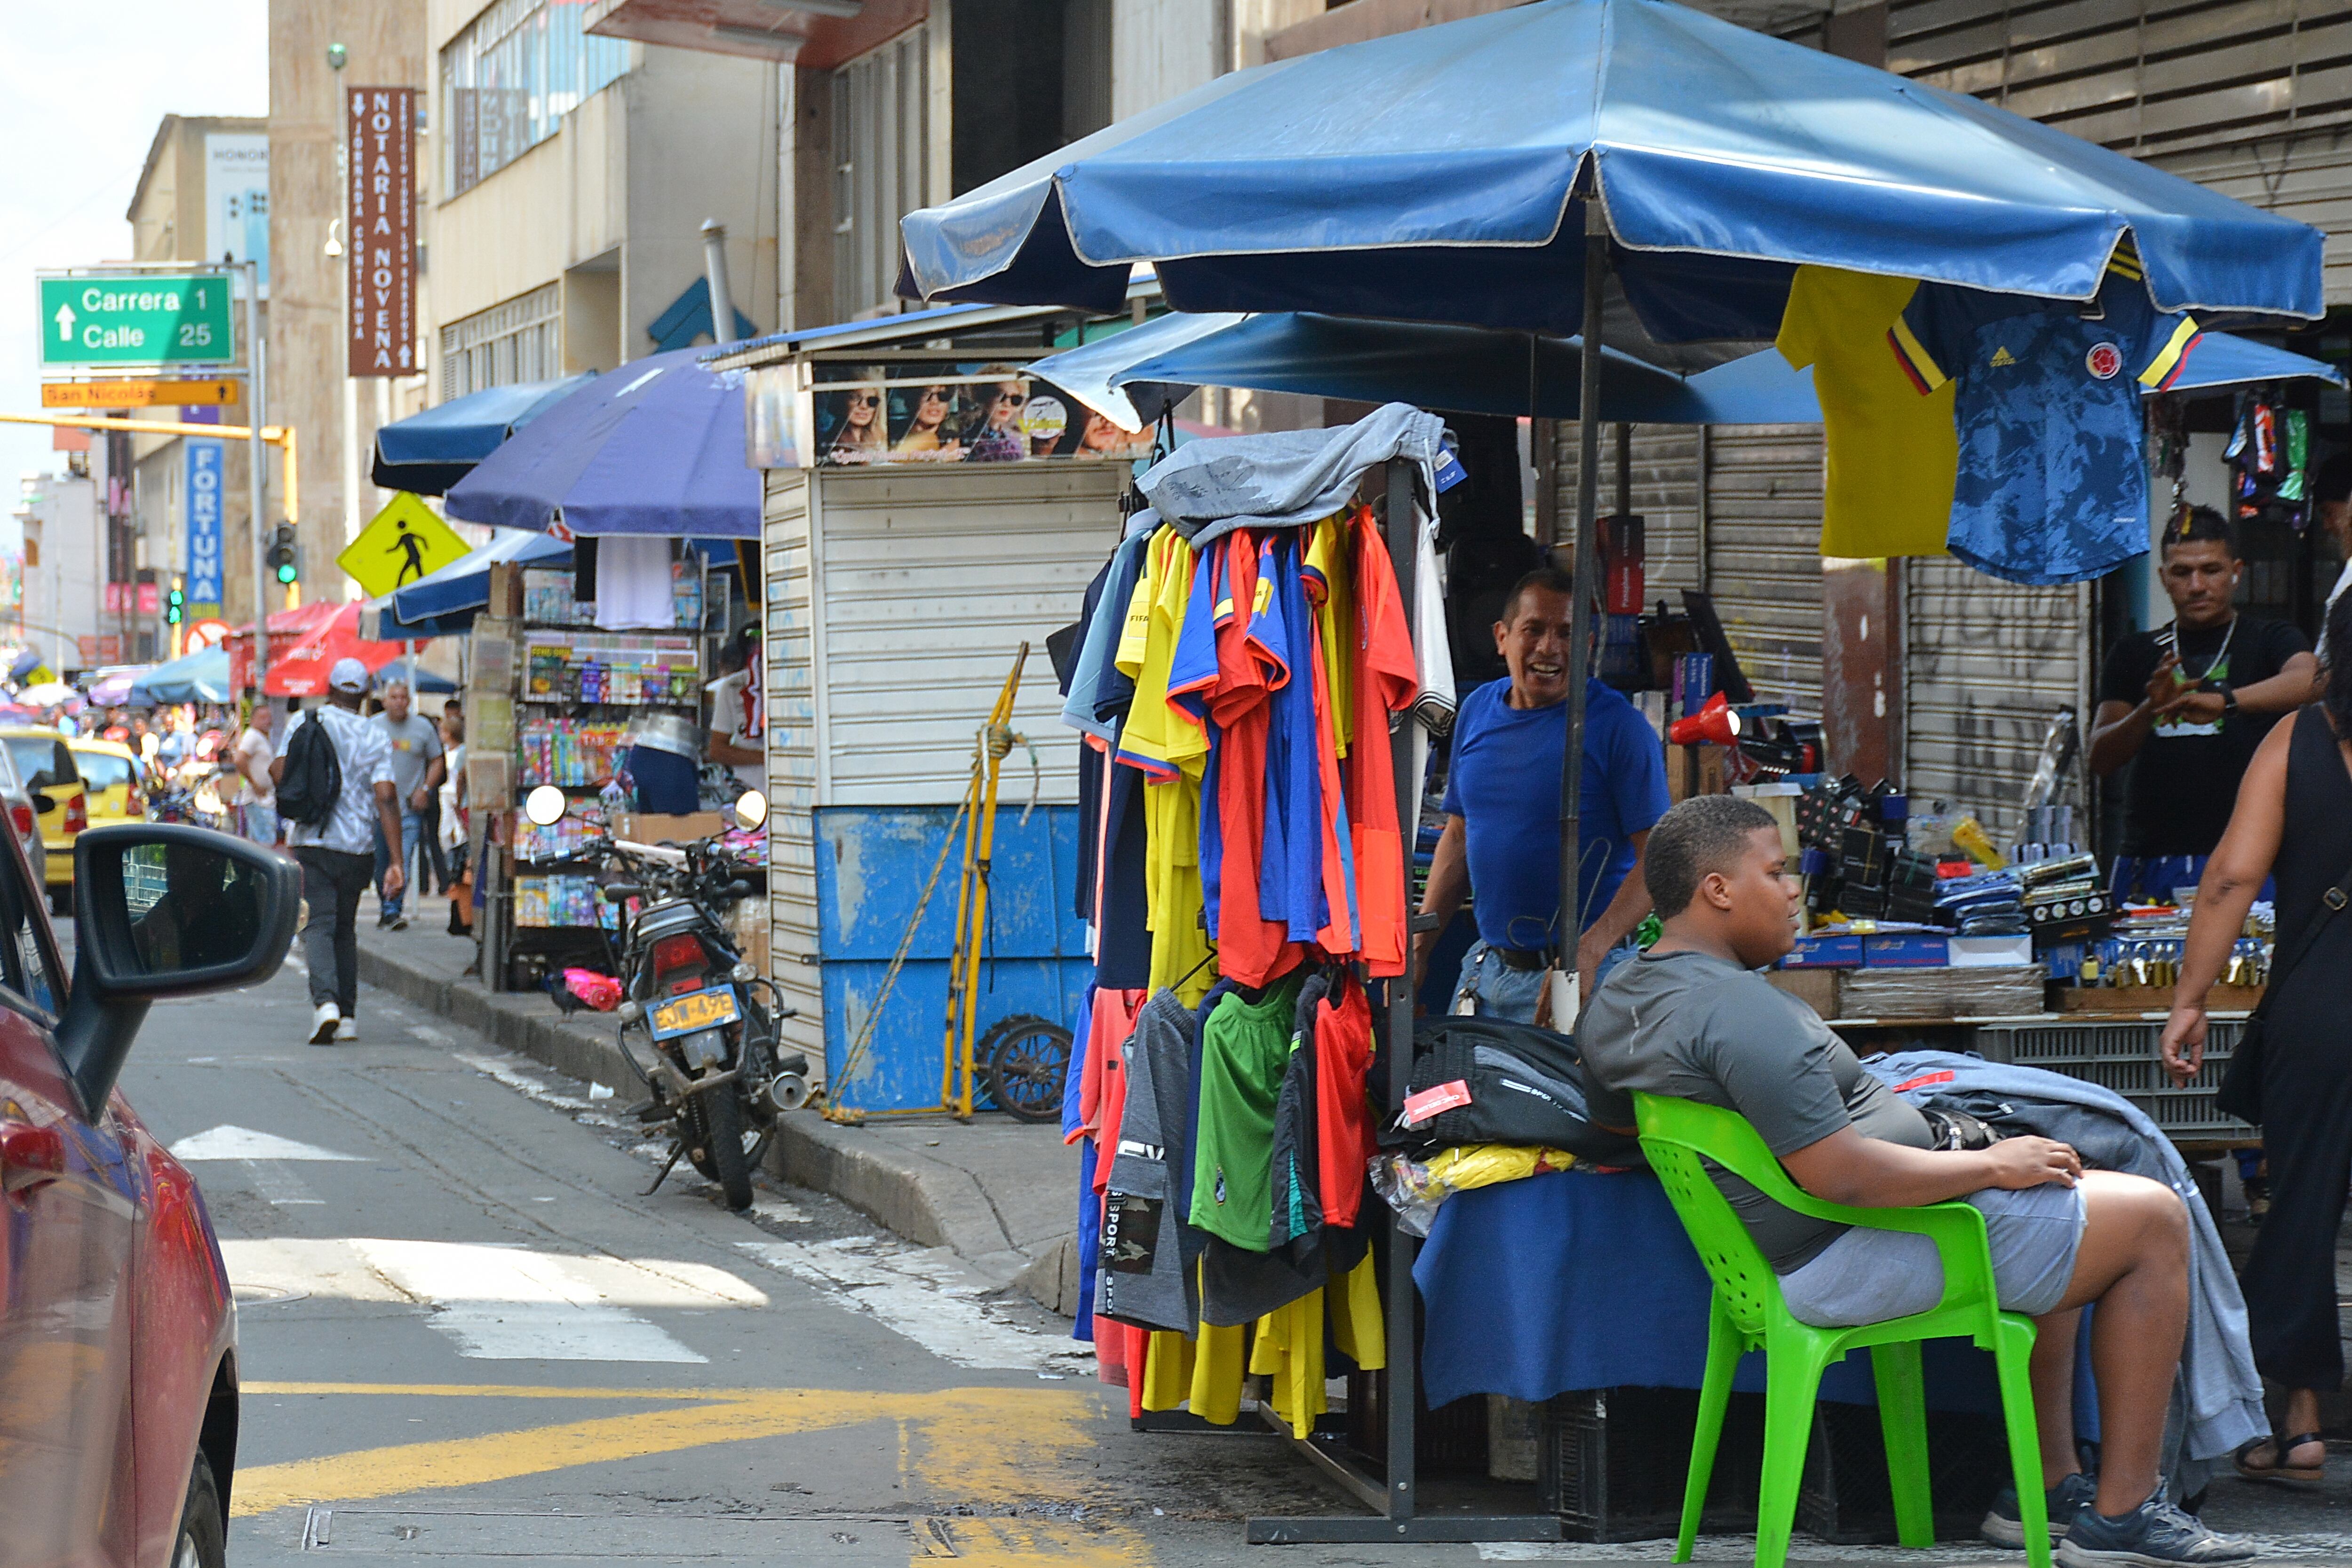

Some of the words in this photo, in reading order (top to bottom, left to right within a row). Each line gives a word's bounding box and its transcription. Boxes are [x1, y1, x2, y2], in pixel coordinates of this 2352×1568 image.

[372, 93, 391, 235] NOTARIA
[82, 287, 180, 311] Carrera
[195, 288, 206, 310] 1
[82, 324, 145, 348] Calle
[179, 323, 212, 347] 25
[354, 224, 365, 340] CONTINUA
[373, 248, 393, 368] NOVENA
[193, 448, 218, 600] FORTUNA
[1106, 1205, 1120, 1258] SPORT
